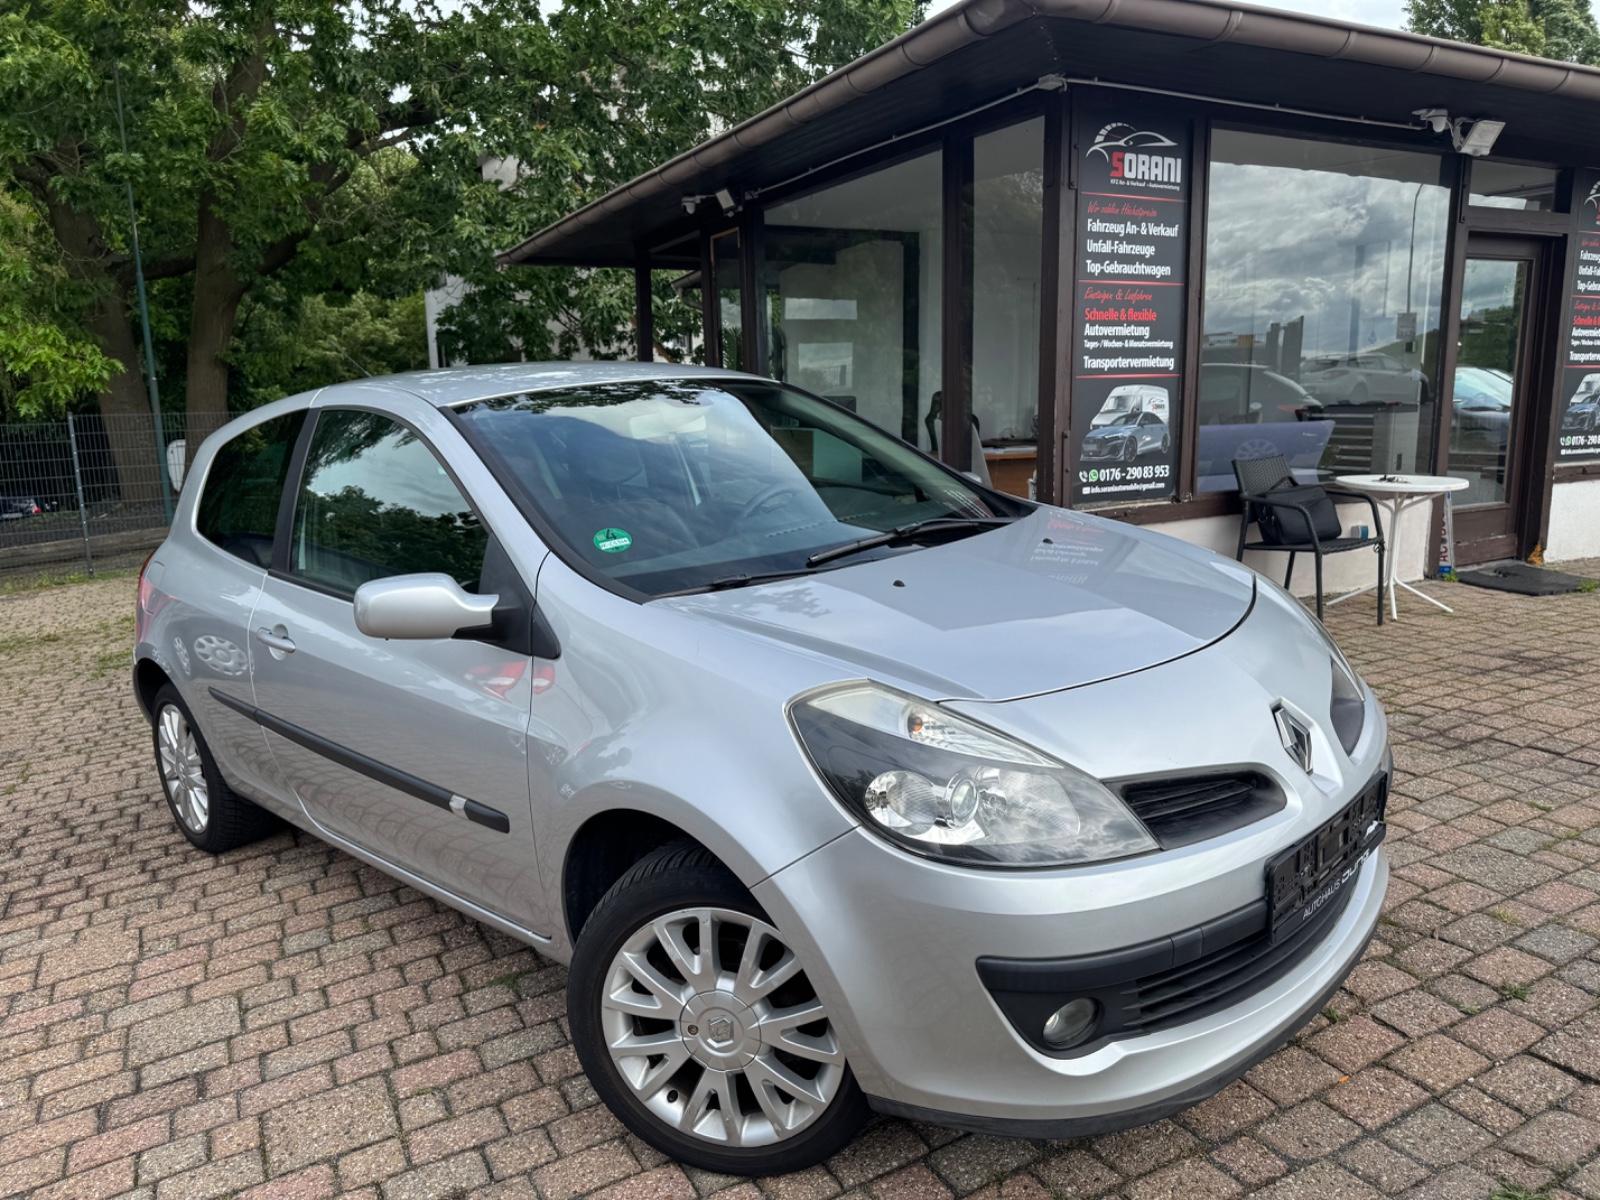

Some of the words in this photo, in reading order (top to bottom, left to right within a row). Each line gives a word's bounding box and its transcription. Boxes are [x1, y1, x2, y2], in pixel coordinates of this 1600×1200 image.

[1110, 151, 1182, 183] SORANI
[1087, 219, 1125, 236] Fahrzeug
[1125, 221, 1139, 235] An-
[1140, 222, 1147, 235] &
[1147, 223, 1179, 237] Verkauf
[1087, 239, 1156, 258] Unfall-Fahrzeuge
[1086, 260, 1171, 278] Top-Gebrauchtwagen
[1084, 307, 1118, 321] Schnelle
[1119, 308, 1127, 321] &
[1127, 308, 1157, 321] flexible
[1084, 323, 1150, 339] Autovermietung
[1083, 355, 1175, 371] Transportervermietung
[1100, 468, 1121, 482] 0176
[1126, 466, 1142, 480] 290
[1143, 465, 1154, 479] 83
[1154, 464, 1170, 478] 953
